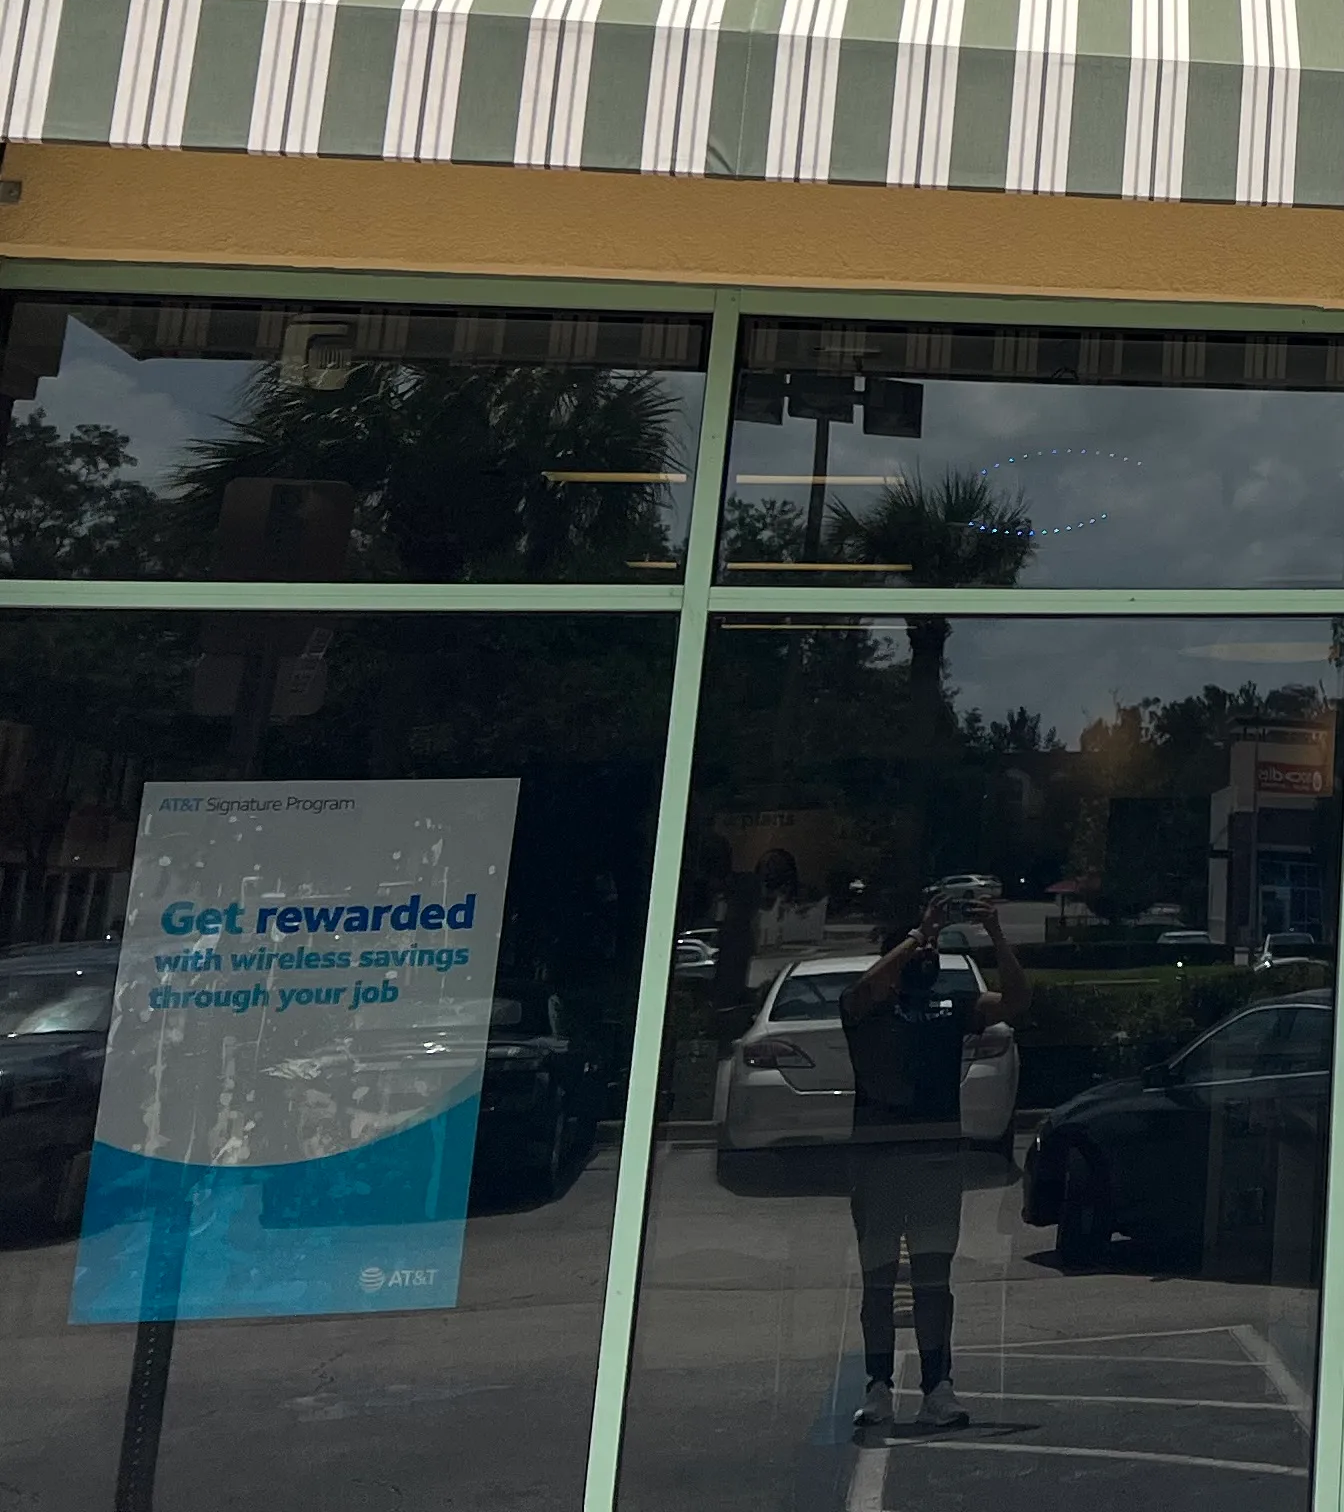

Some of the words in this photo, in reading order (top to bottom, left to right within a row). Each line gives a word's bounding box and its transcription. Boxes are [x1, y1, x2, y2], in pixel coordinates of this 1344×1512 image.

[158, 797, 203, 813] AT&T
[206, 796, 283, 816] Signature
[286, 796, 356, 815] Program
[160, 900, 247, 936] Get
[256, 893, 477, 935] rewarded
[154, 947, 222, 973] with
[231, 946, 351, 971] wireless
[359, 942, 470, 972] savings
[148, 982, 270, 1014] through
[275, 984, 347, 1014] your
[348, 979, 400, 1011] job
[387, 1268, 439, 1288] AT&T
